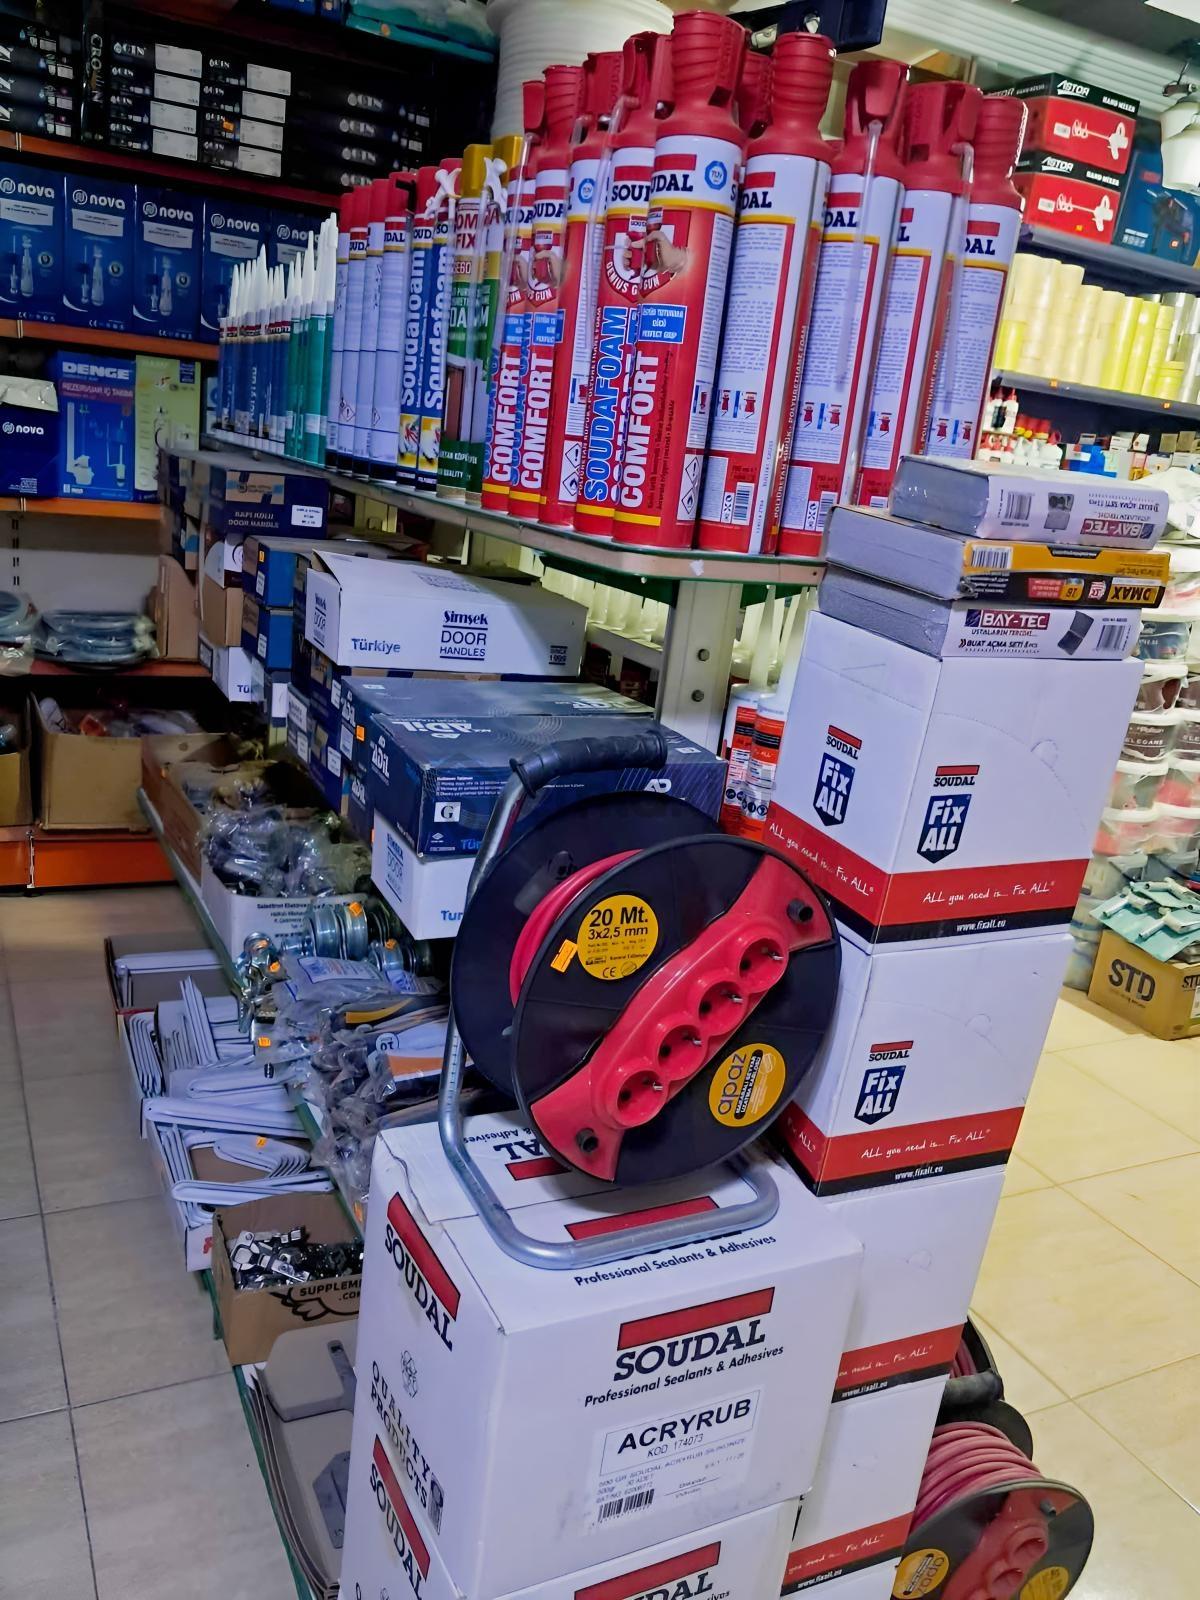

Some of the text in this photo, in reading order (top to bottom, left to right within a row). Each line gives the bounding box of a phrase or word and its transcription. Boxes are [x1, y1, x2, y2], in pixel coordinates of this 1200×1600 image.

[18, 182, 54, 198] nova
[90, 196, 126, 210] nova
[159, 206, 194, 222] nova
[226, 219, 260, 233] nova
[62, 362, 130, 380] DENGE
[584, 306, 628, 502] SOUDAFOAM
[492, 352, 520, 482] COMFORT
[520, 352, 554, 489] COMFORT
[16, 424, 44, 435] nova
[621, 351, 659, 508] COMFORT
[1082, 520, 1145, 538] BAY-TEC
[1112, 586, 1152, 602] DMAX
[982, 612, 1048, 628] BAY-TEC
[351, 638, 400, 654] Türkiye
[440, 630, 487, 646] DOOR
[440, 646, 486, 657] HANDLES
[826, 736, 859, 760] SOUDAL
[933, 776, 976, 787] SOUDAL
[817, 786, 845, 820] ALL
[769, 822, 786, 840] ALL
[787, 836, 800, 850] you
[800, 848, 820, 863] need
[922, 826, 958, 852] ALL
[924, 892, 944, 903] ALL
[948, 894, 964, 904] you
[968, 890, 990, 900] need
[590, 906, 648, 928] 20 Mt.
[956, 918, 1006, 932] www.fixall.eu
[588, 926, 648, 940] 3x2,5 mm
[1108, 958, 1156, 1002] STD
[868, 1050, 910, 1062] SOUDAL
[858, 1092, 894, 1118] ALL
[861, 1149, 882, 1159] ALL
[894, 1164, 944, 1181] www.fixall.eu
[574, 1234, 777, 1287] Professional Sealants & Adhesives
[384, 1224, 453, 1352] SOUDAL
[613, 1320, 766, 1382] SOUDAL
[584, 1345, 784, 1408] Professional Sealants & Adhesives
[372, 1360, 430, 1482] QUALITY
[617, 1398, 752, 1454] ACRYRUB
[370, 1382, 428, 1510] PRODUCTS
[647, 1444, 668, 1458] KOD
[674, 1434, 704, 1451] 174073
